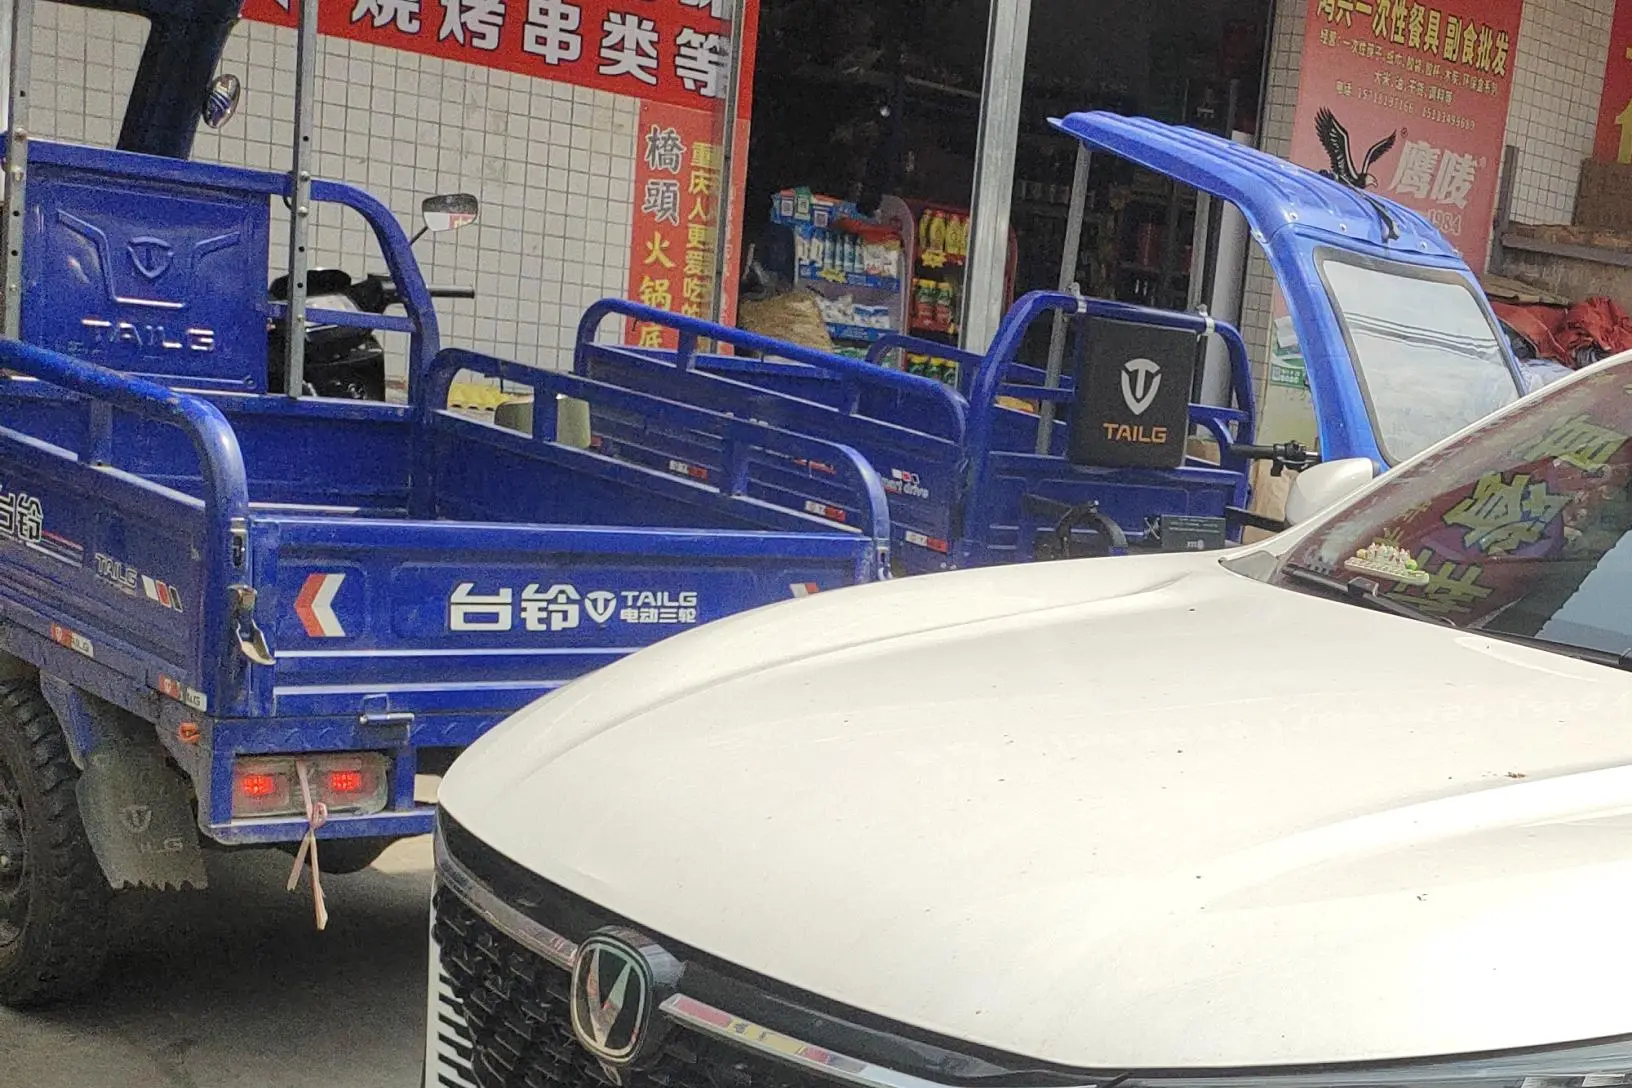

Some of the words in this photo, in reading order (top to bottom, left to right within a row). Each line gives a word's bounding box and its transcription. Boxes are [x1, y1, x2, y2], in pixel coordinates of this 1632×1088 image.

[81, 316, 215, 351] TAILG
[1103, 423, 1168, 443] TAILG
[95, 552, 138, 589] TAILG
[450, 582, 582, 632] 台铃
[621, 591, 697, 606] TAILG
[620, 608, 697, 624] 电动三轮
